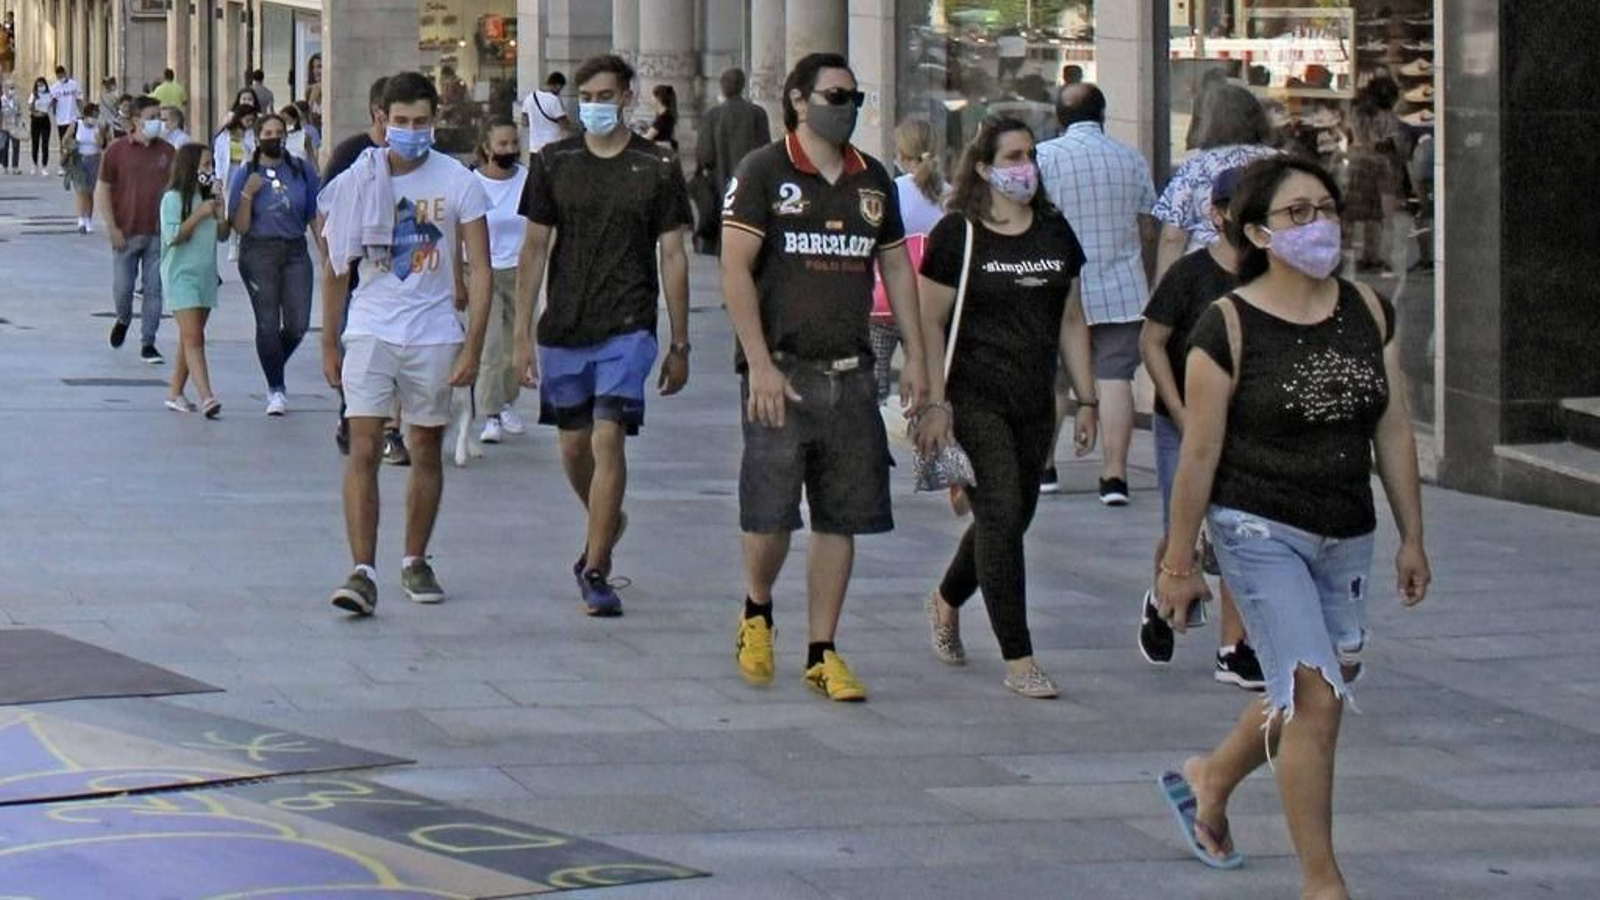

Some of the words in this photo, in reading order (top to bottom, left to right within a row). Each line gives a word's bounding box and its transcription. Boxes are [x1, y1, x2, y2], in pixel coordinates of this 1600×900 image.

[722, 177, 739, 216] 2
[779, 182, 804, 214] 2
[986, 258, 1062, 275] simplicity
